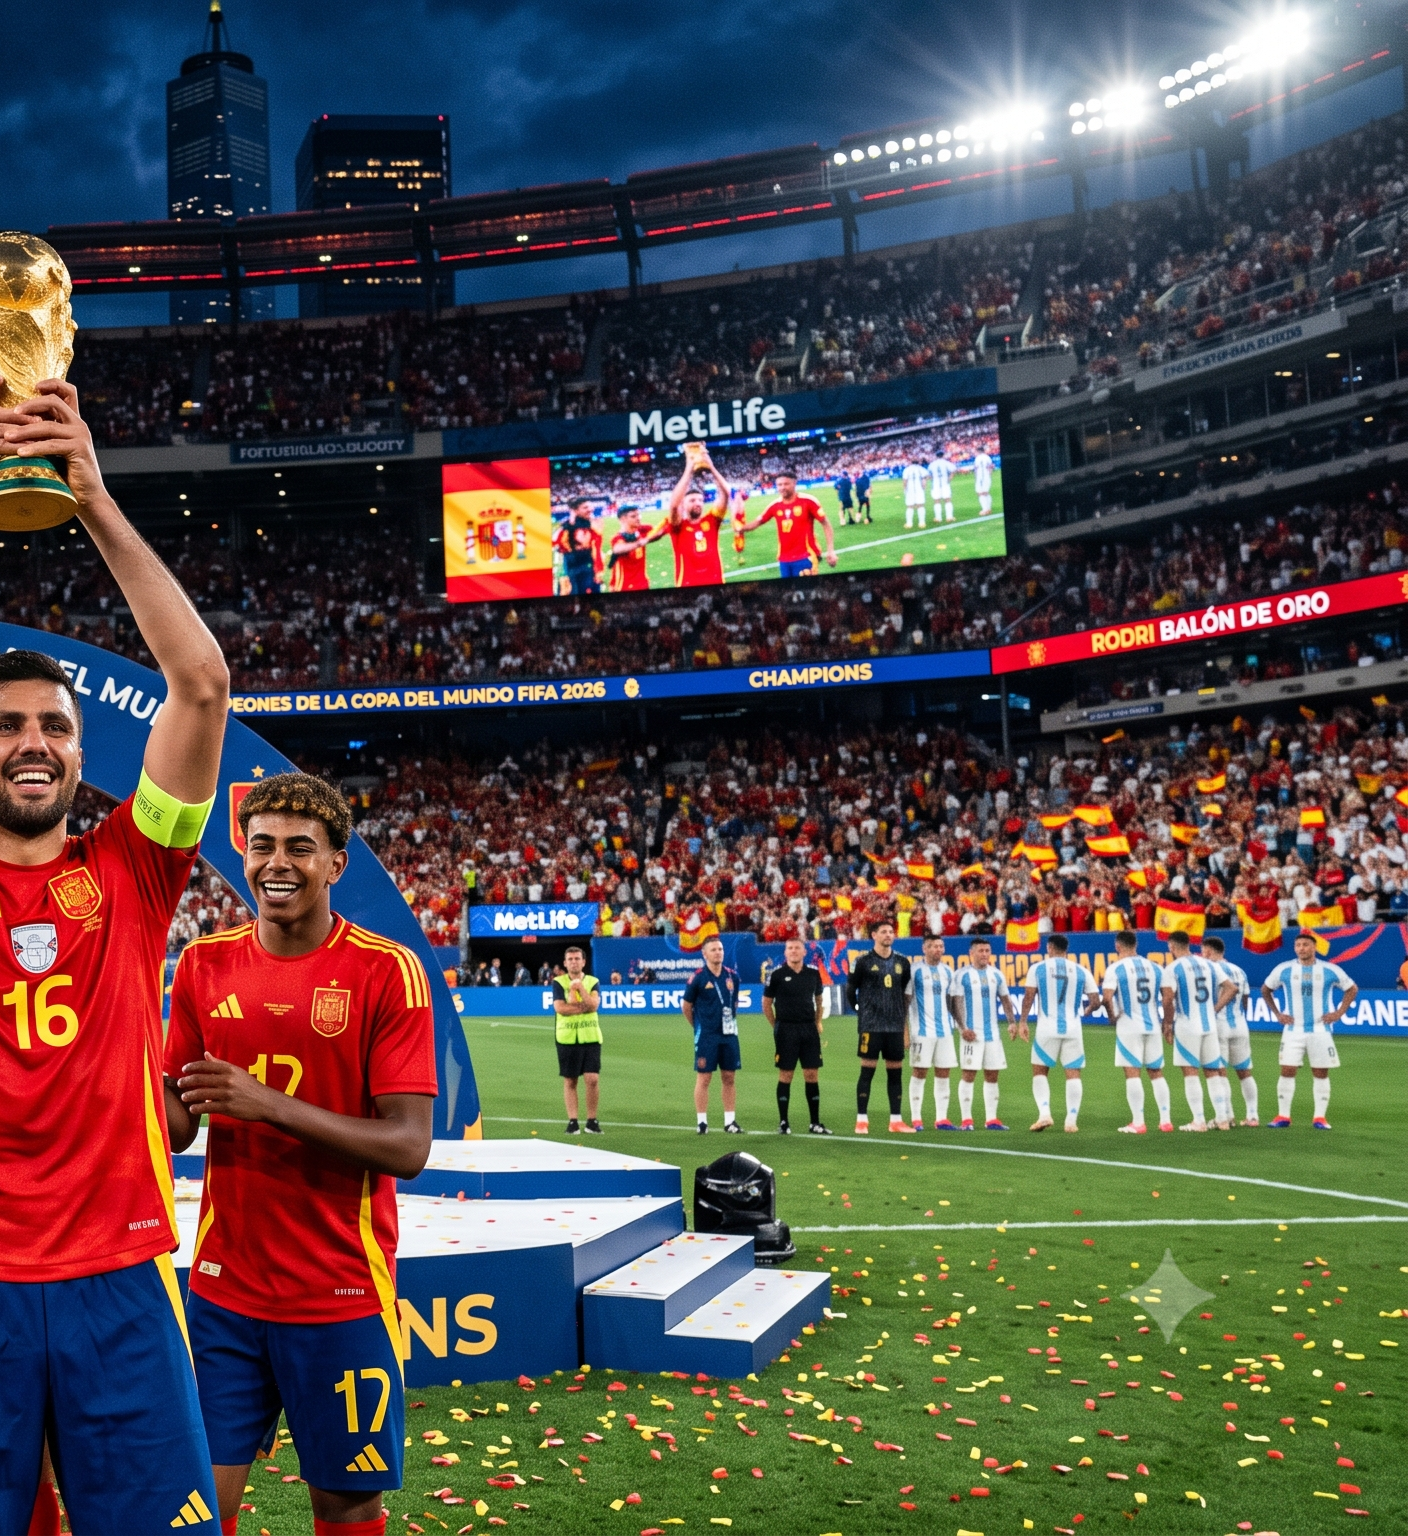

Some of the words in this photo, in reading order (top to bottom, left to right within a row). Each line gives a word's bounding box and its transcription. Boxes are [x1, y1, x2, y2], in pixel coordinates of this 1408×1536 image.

[628, 397, 786, 445] MetLife
[1091, 624, 1155, 653] RODRI
[1159, 605, 1235, 642] BALÓN
[1239, 602, 1273, 627] DE
[1276, 591, 1330, 621] ORO
[228, 696, 293, 712] EONES
[296, 695, 321, 711] DE
[324, 694, 348, 710] LA
[351, 692, 401, 709] COPA
[404, 690, 440, 707] DEL
[443, 687, 514, 705] MUNDO
[517, 684, 557, 702] FIFA
[561, 681, 606, 700] 2026
[749, 663, 873, 688] CHAMPIONS
[99, 676, 164, 726] MU
[494, 910, 579, 931] MetLife
[3, 974, 79, 1049] 16
[1136, 978, 1151, 1004] 5
[1194, 977, 1209, 1004] 5
[249, 1054, 303, 1097] 17
[334, 1367, 391, 1433] 17
